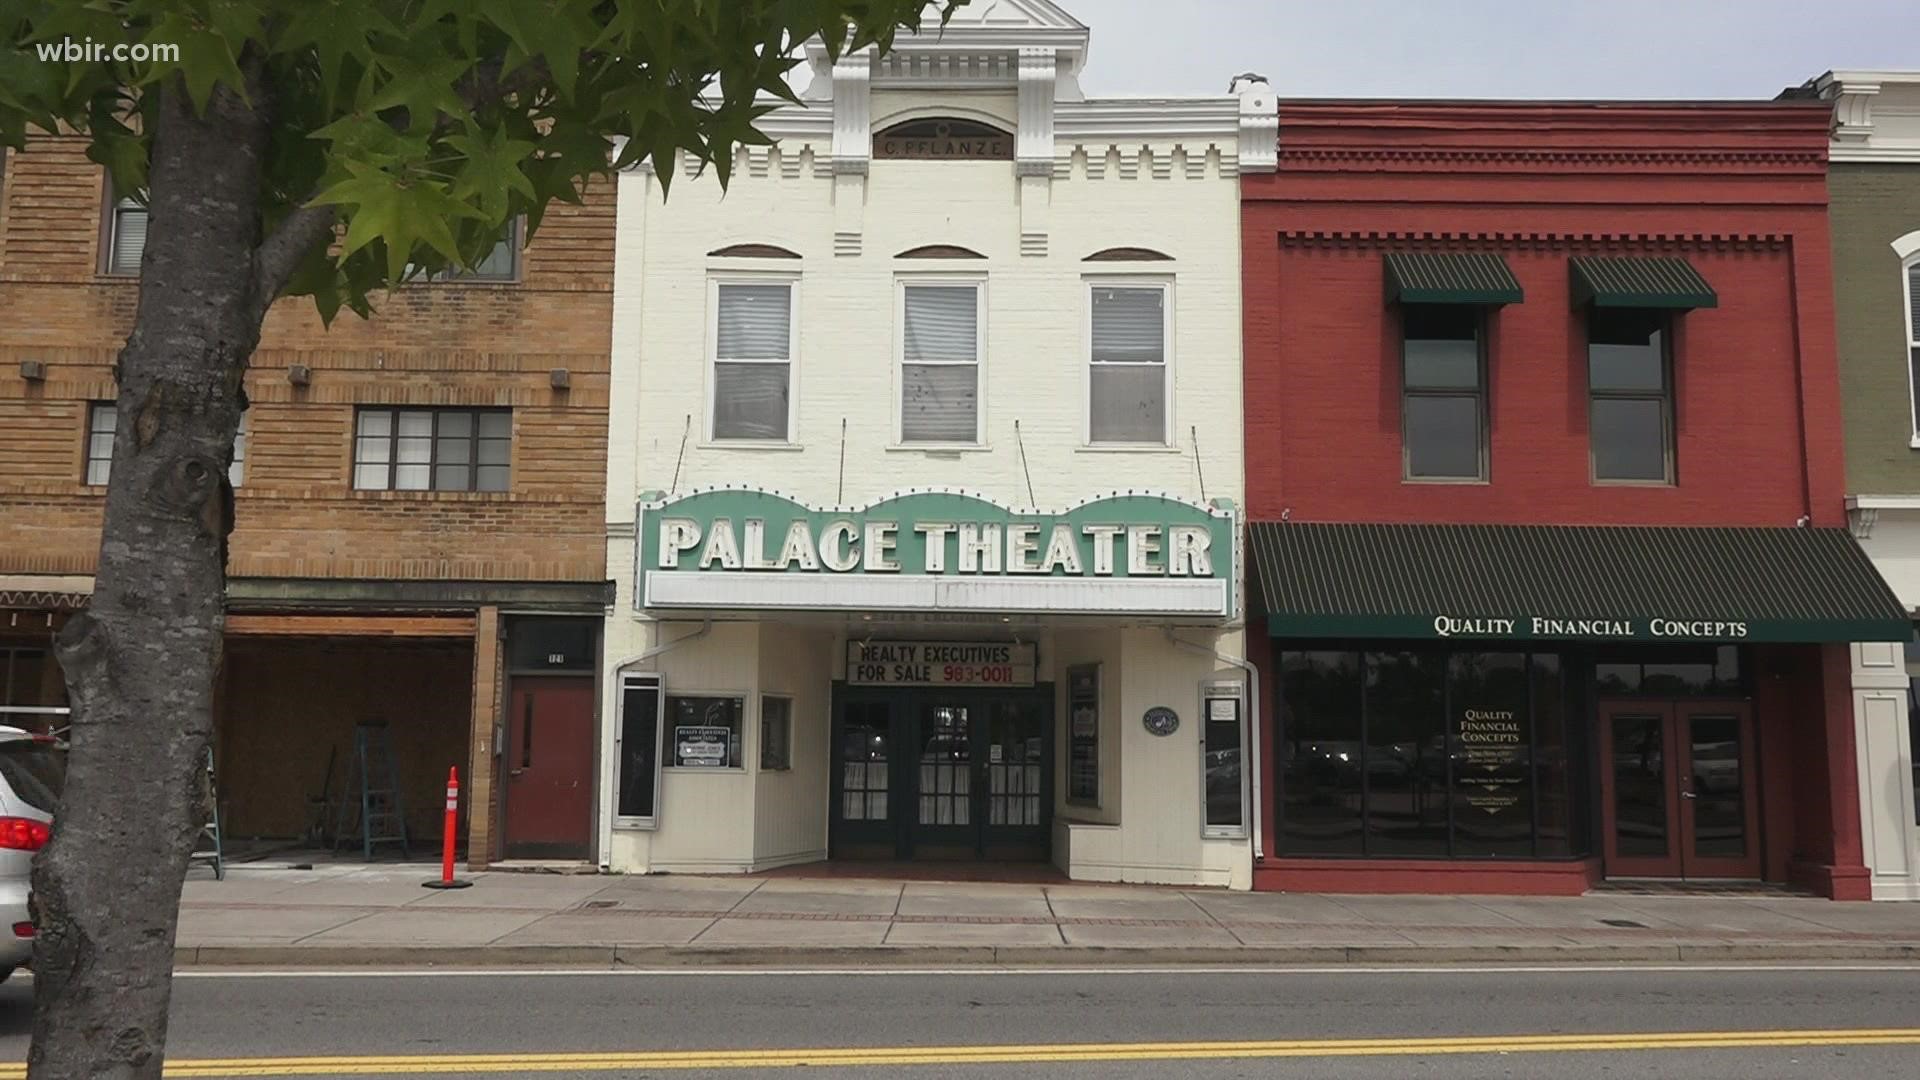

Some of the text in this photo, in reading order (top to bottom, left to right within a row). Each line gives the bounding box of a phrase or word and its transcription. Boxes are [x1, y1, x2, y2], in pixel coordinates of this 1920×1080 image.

[658, 517, 1215, 577] PALACE THEATER
[1434, 615, 1747, 637] QUALITY FINANCIAL CONCEPTS
[861, 646, 1010, 664] REALTY EXECUTIVES
[857, 665, 1013, 683] FOR SALE 983-0011
[1465, 709, 1513, 721] QUALITY
[1460, 721, 1520, 731] FINANCIAL
[1461, 731, 1520, 742] CONCEPTS
